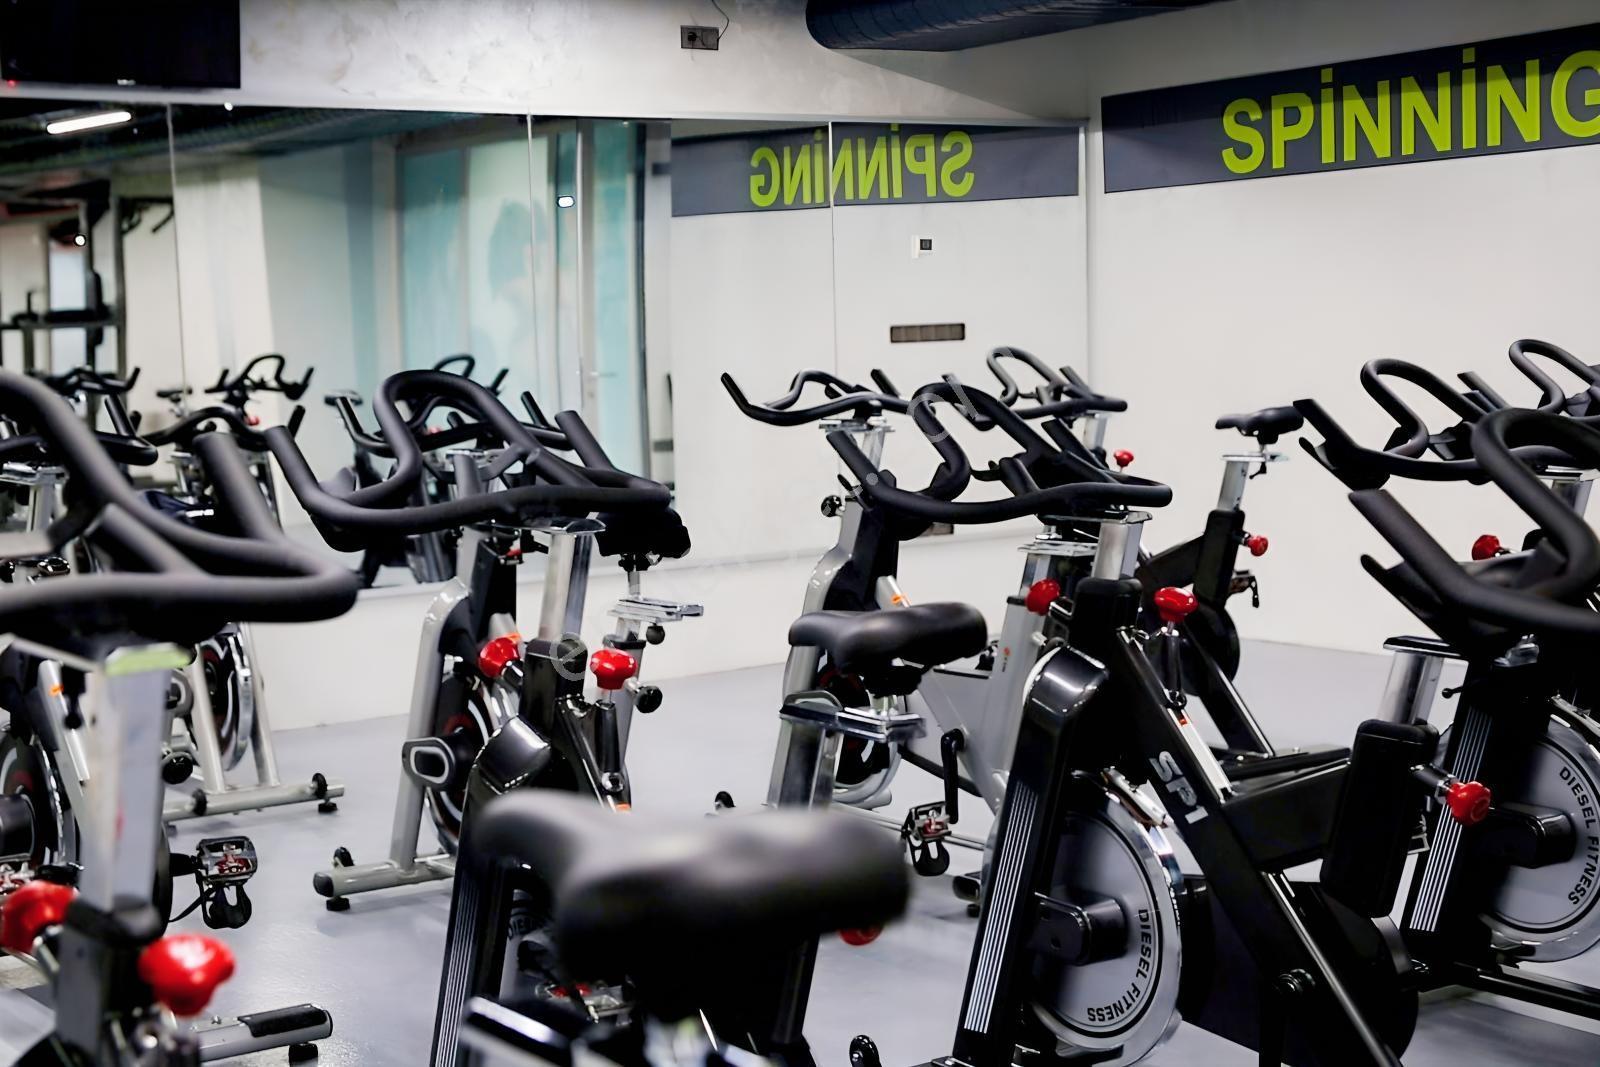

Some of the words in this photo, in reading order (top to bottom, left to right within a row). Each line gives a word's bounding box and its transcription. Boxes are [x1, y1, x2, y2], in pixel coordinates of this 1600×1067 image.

[1560, 766, 1596, 829] DIESEL
[1567, 836, 1600, 905] FITNESS
[1136, 908, 1152, 979] DIESEL
[1087, 982, 1141, 1022] FITNESS
